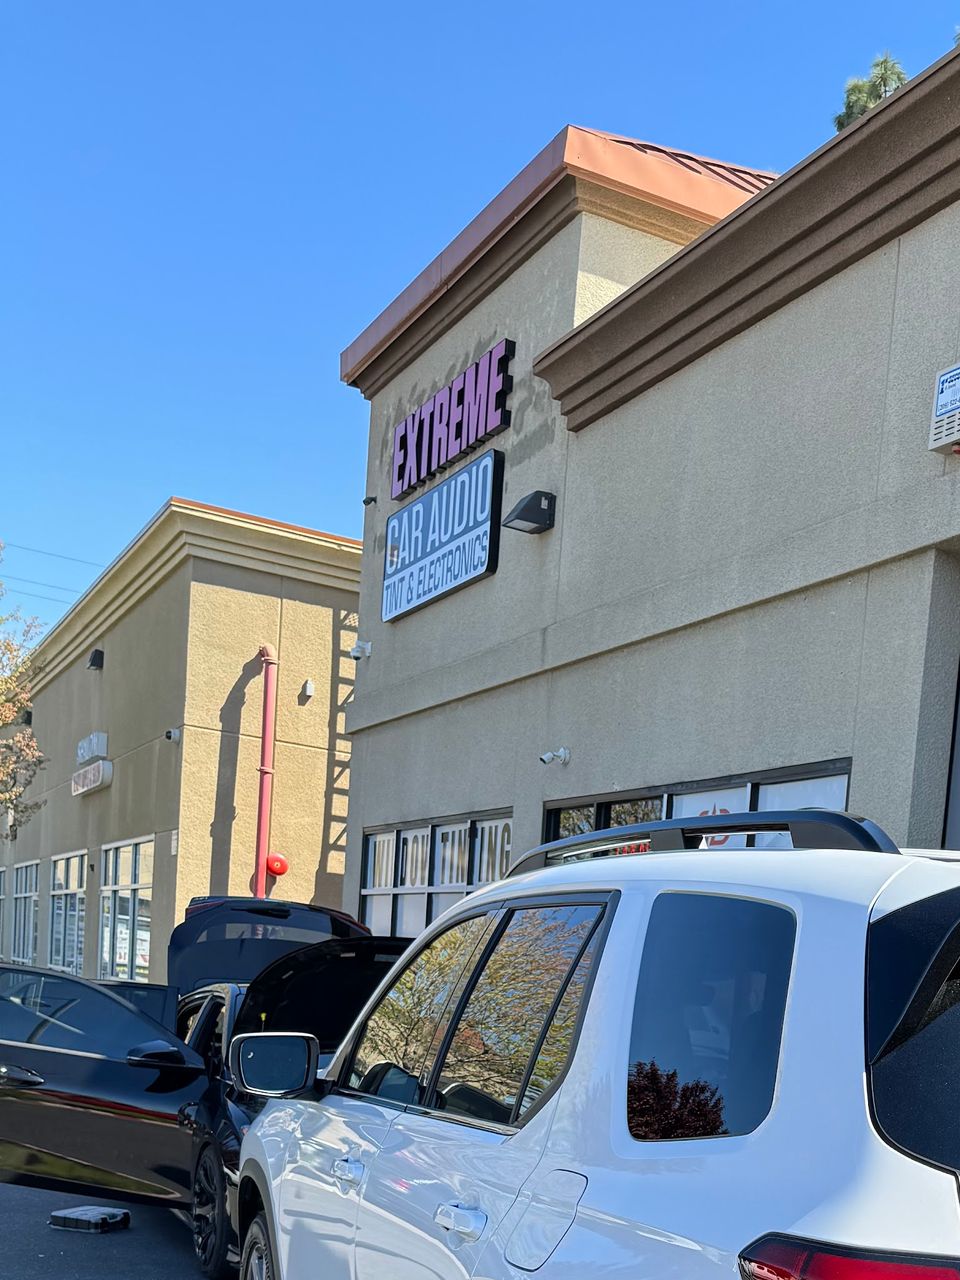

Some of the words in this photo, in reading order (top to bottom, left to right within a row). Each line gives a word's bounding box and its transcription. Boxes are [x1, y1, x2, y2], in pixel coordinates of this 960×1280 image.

[391, 339, 507, 500] EXTREME
[386, 502, 424, 576] CAR
[427, 455, 494, 553] AUDIO
[384, 574, 405, 617] TINT
[406, 570, 416, 603] &
[416, 530, 488, 600] ELECTRONICS
[372, 834, 430, 888] WIDOW
